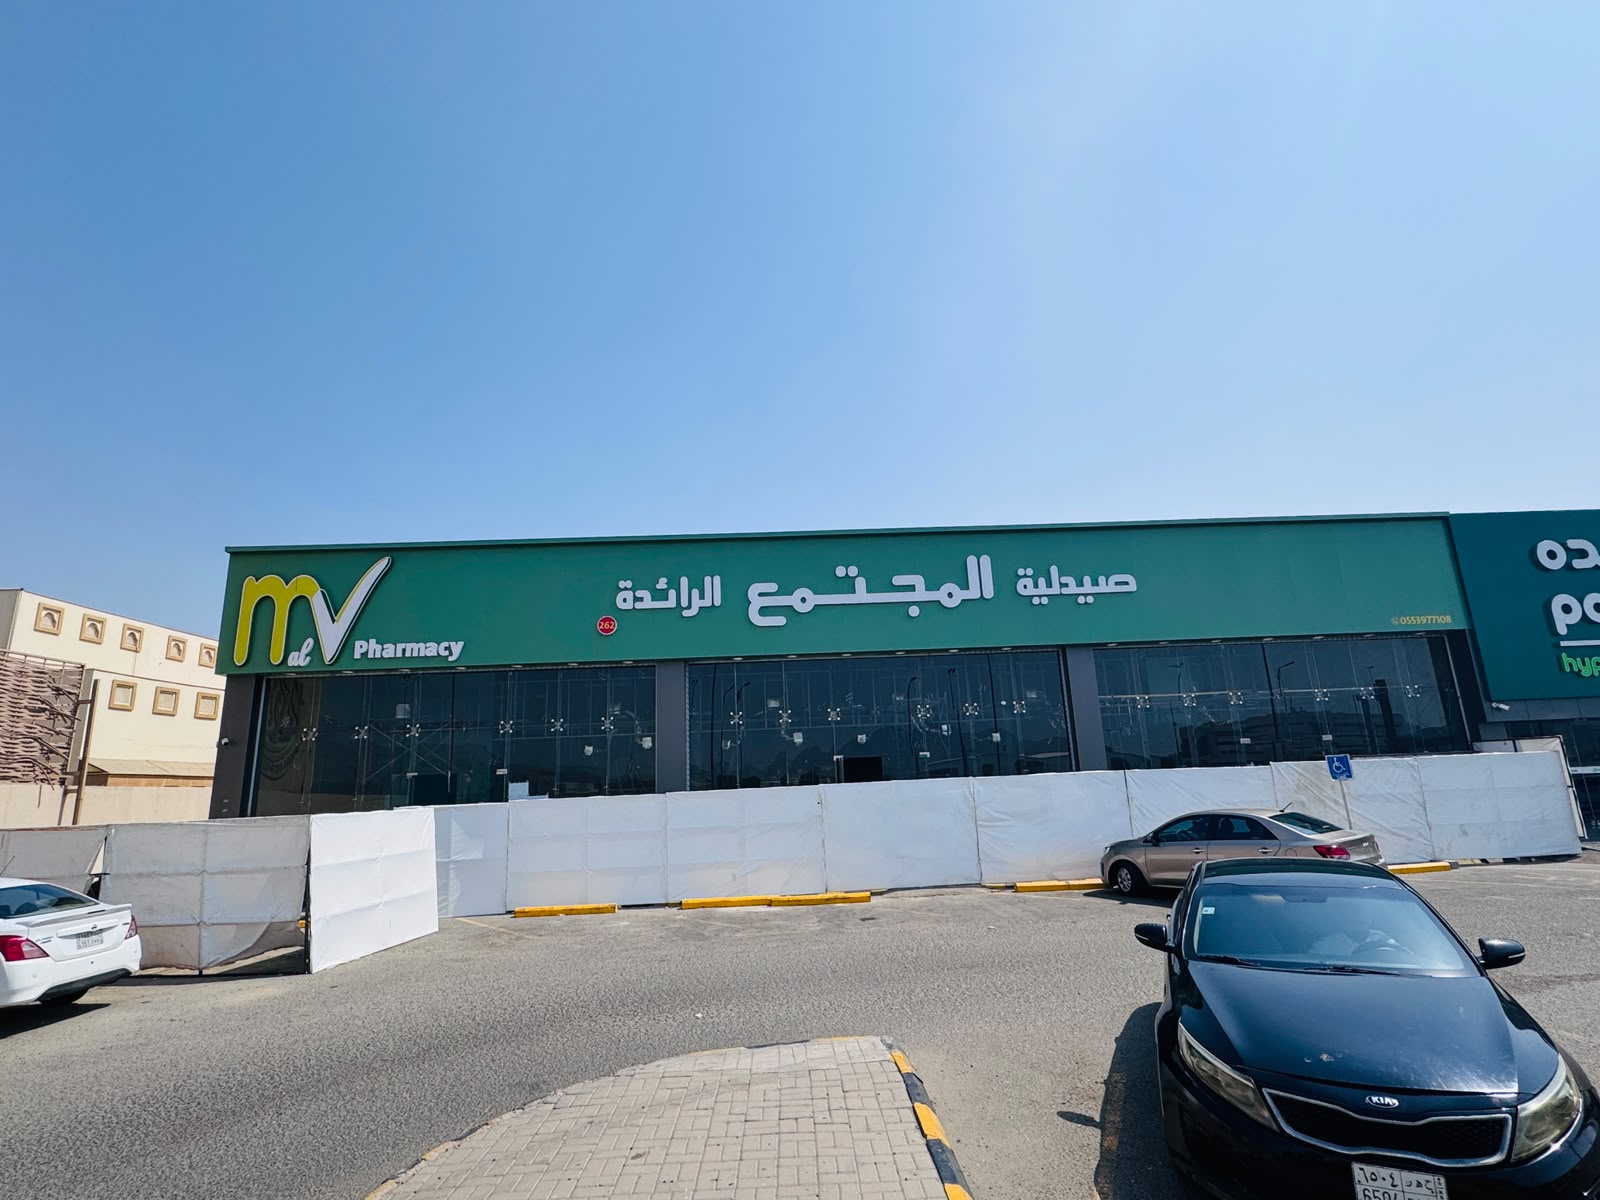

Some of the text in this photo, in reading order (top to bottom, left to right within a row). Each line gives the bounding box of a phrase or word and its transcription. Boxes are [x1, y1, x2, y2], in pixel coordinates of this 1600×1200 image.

[616, 554, 1137, 627] صيدلية المجتمع الرائدة
[1400, 615, 1452, 625] 0553977108
[599, 621, 615, 630] 262
[353, 638, 465, 662] Pharmacy
[1371, 1096, 1394, 1106] KIA
